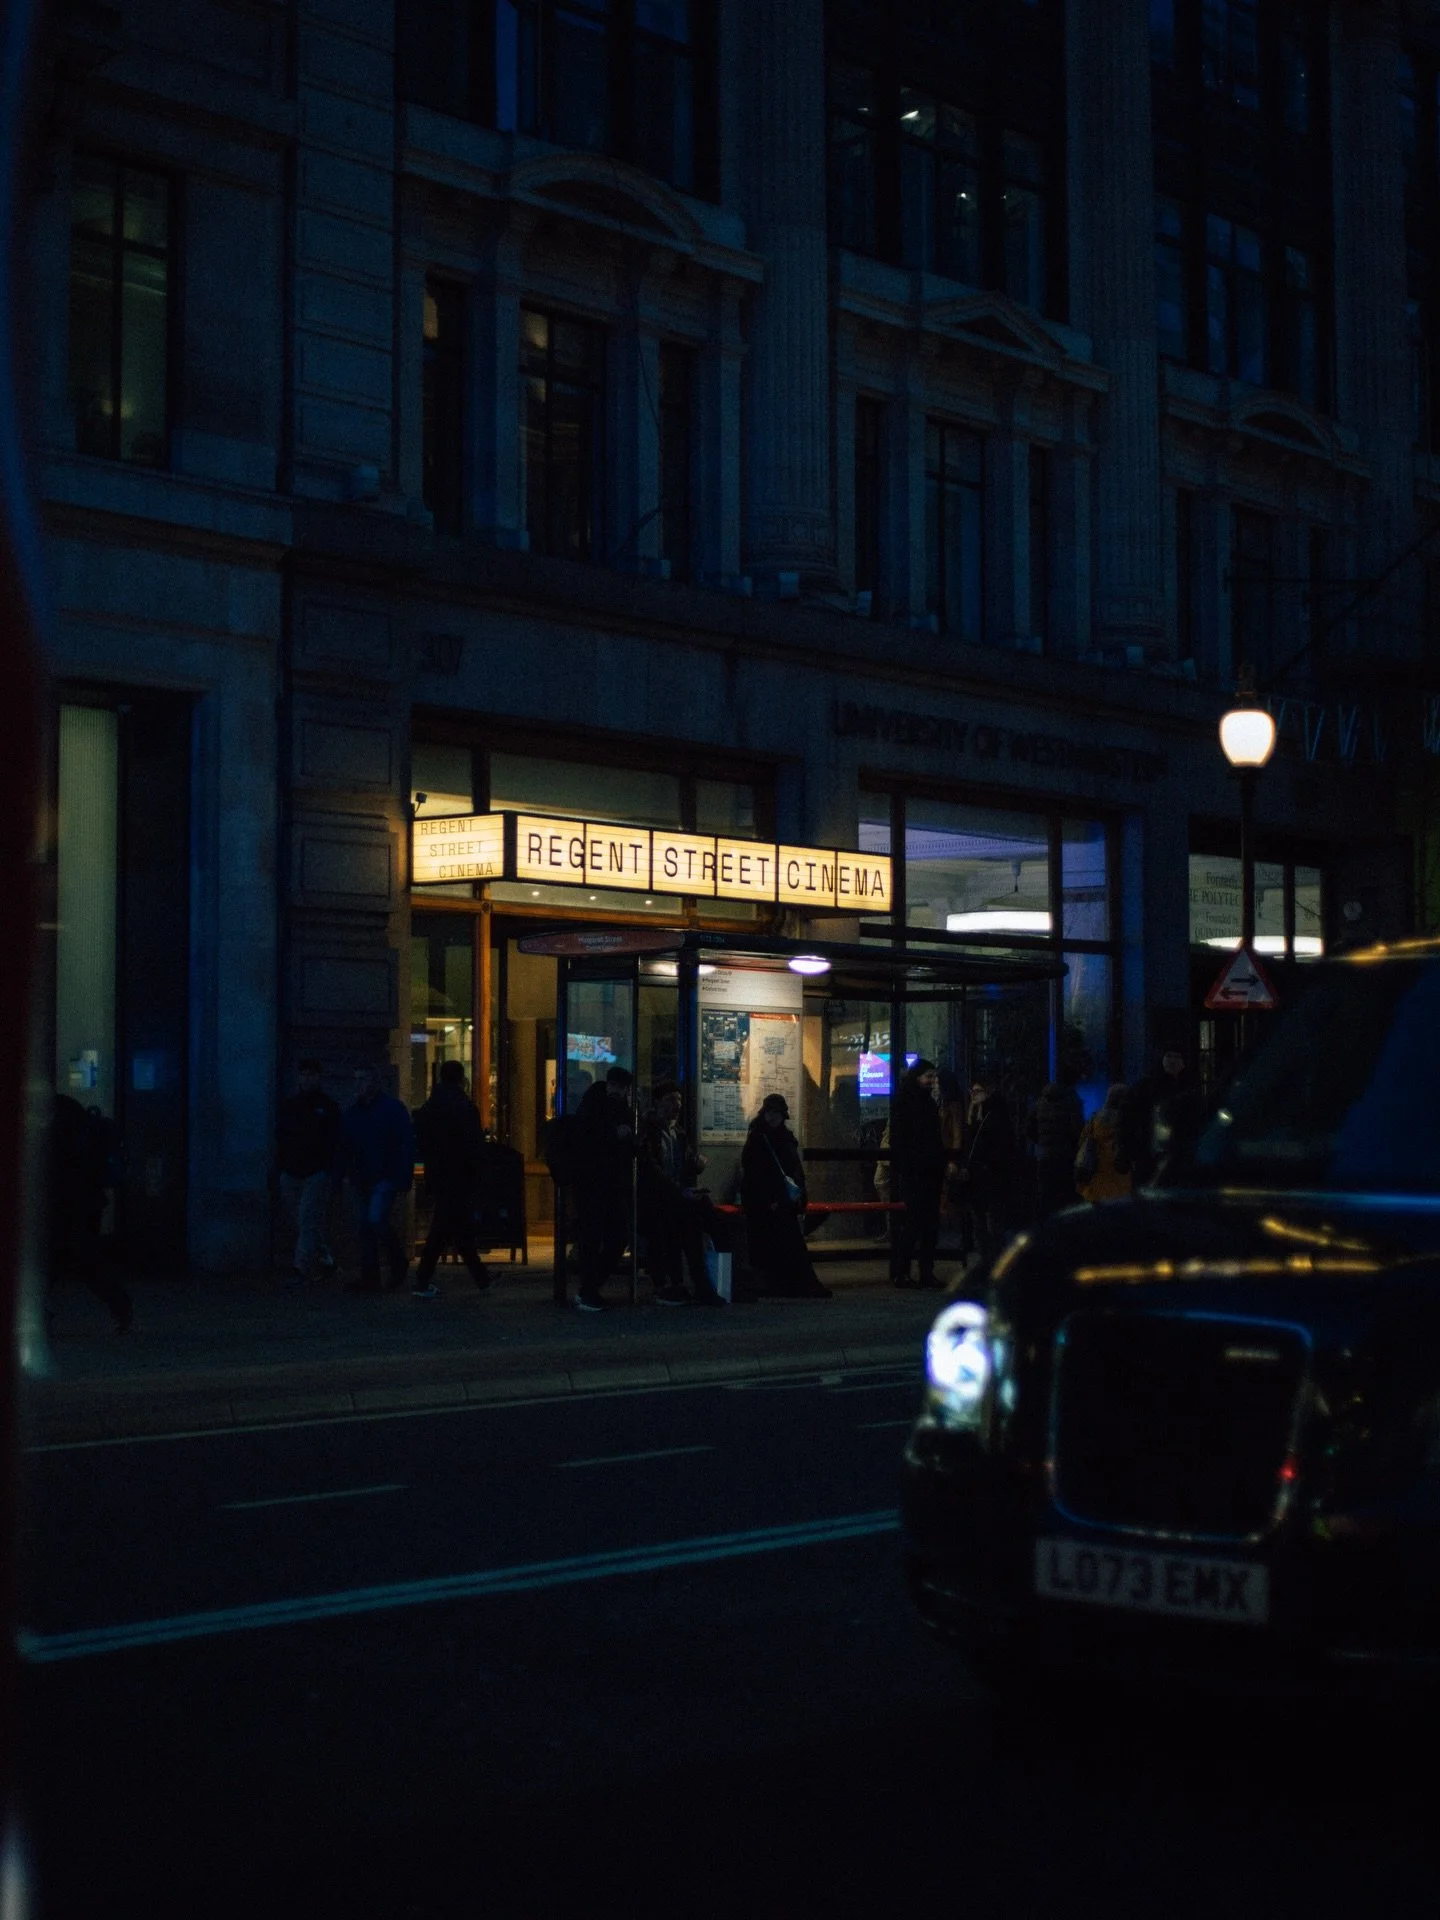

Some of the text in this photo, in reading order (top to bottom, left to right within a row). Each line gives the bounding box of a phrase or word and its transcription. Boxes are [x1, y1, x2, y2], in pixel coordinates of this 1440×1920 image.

[421, 819, 474, 836] REGENT
[430, 840, 482, 857] STREET
[439, 862, 494, 879] CINEMA
[528, 832, 885, 898] REGENT STREET CINEMA
[1050, 1550, 1249, 1615] LO73 EMX
